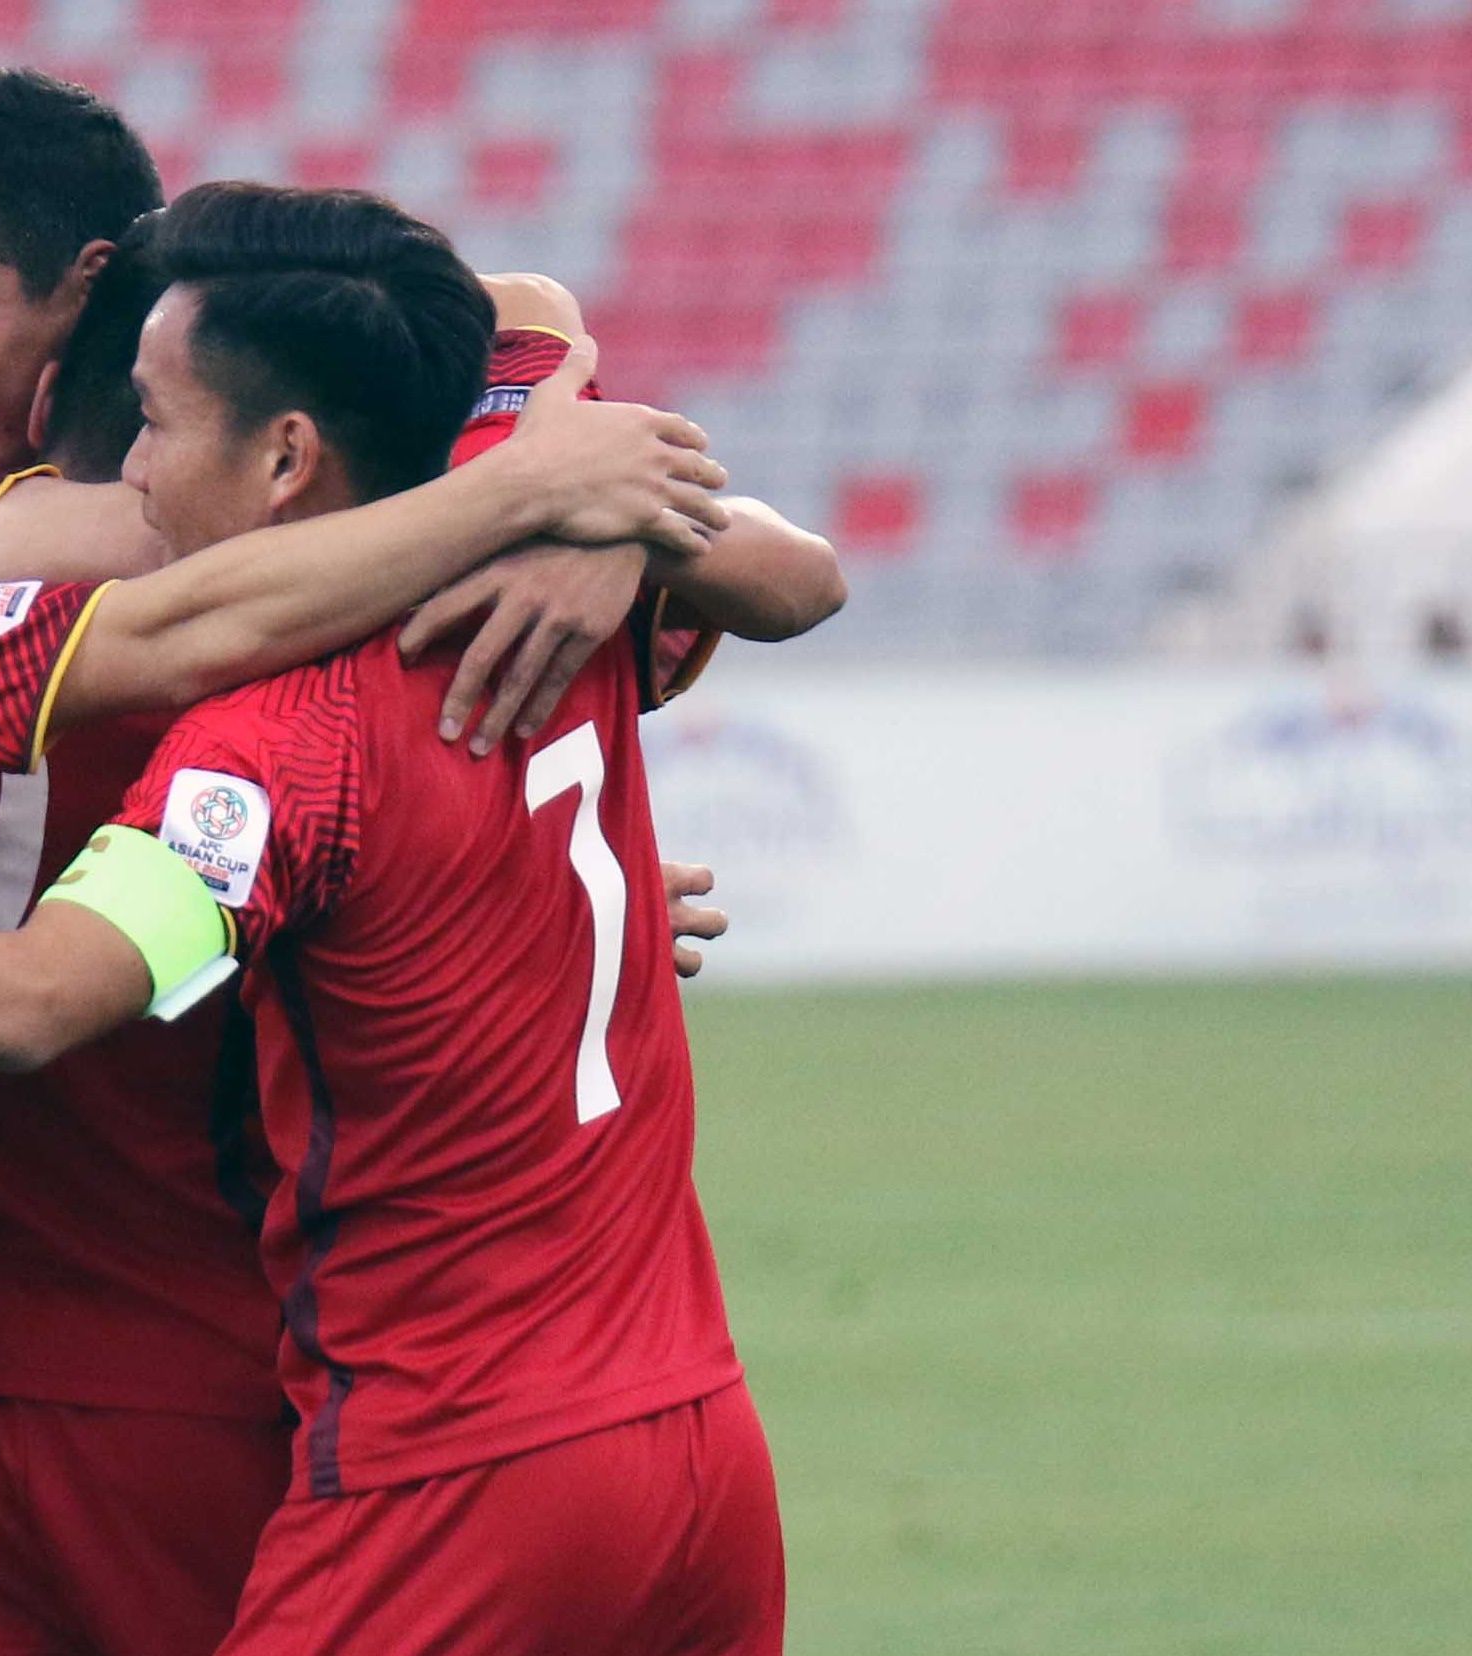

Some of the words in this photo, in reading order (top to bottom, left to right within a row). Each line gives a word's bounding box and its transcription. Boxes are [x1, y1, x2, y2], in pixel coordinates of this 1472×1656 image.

[168, 841, 214, 863] ASIAN
[216, 855, 249, 874] CUP
[199, 838, 223, 853] AFC
[525, 720, 627, 1125] 7
